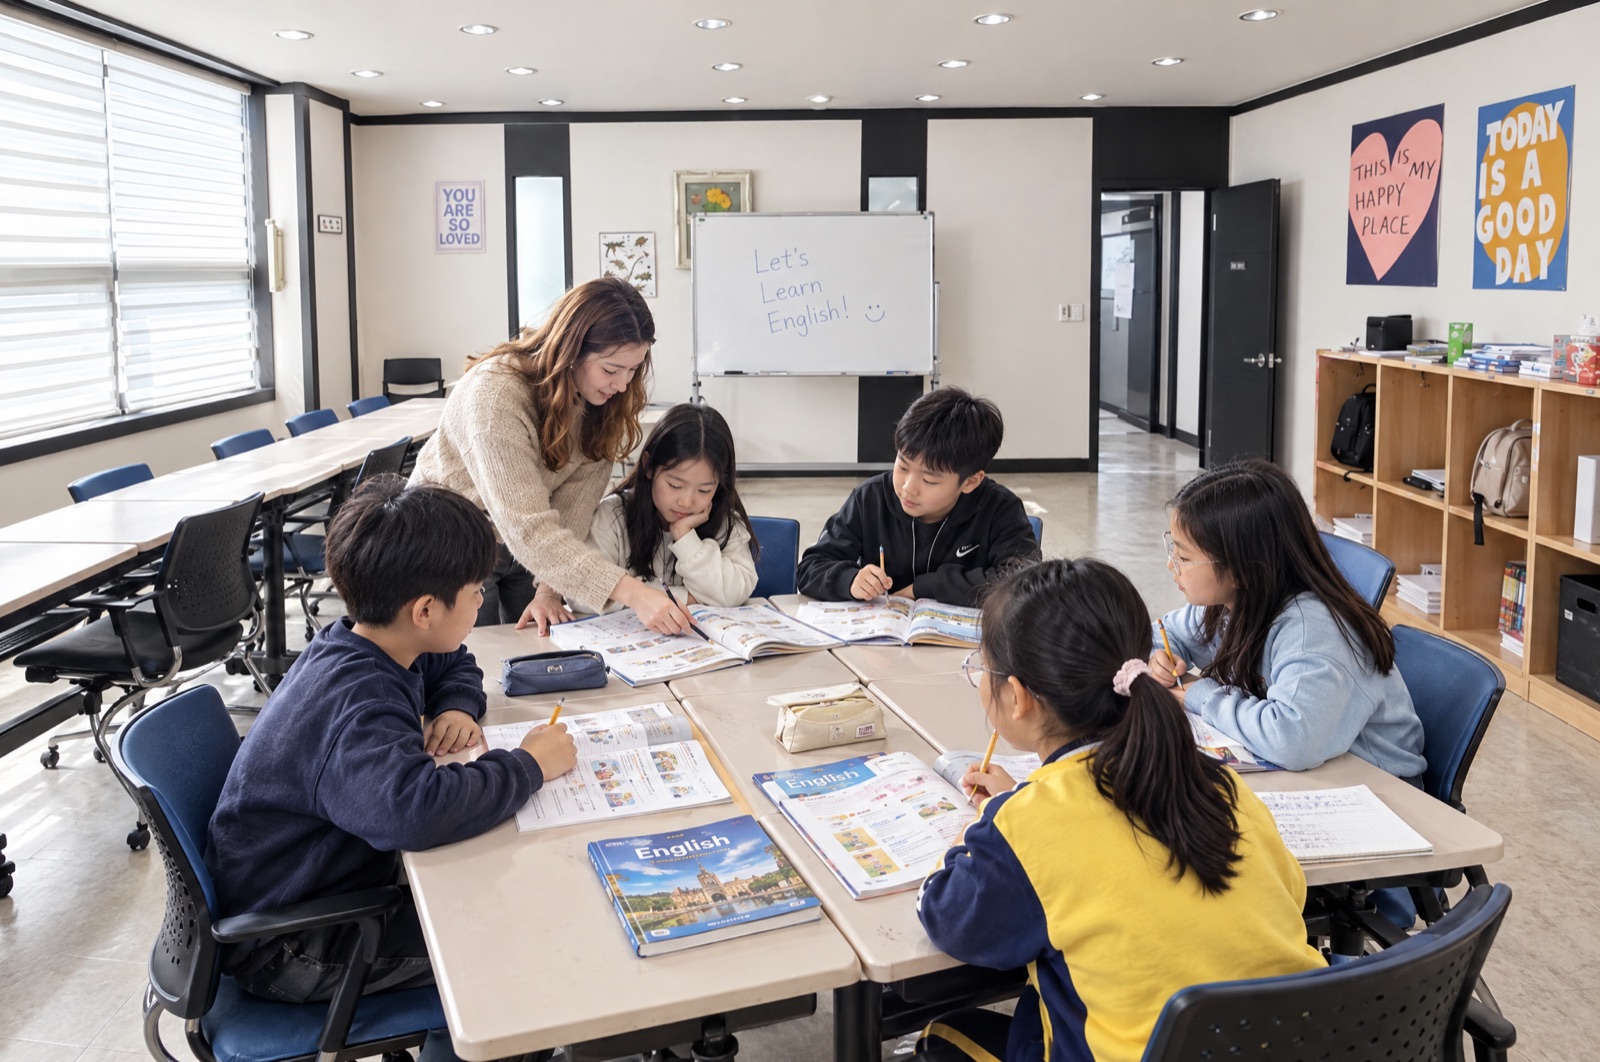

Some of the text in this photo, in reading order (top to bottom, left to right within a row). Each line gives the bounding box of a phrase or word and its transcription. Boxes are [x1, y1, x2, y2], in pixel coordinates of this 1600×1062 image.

[1486, 99, 1565, 156] TODAY
[1353, 148, 1437, 181] THIS IS MY
[1478, 148, 1542, 200] IS A
[442, 188, 476, 203] YOU
[1355, 182, 1405, 211] HAPPY
[443, 203, 474, 217] ARE
[1476, 193, 1556, 244] GOOD
[448, 218, 471, 231] SO
[1362, 215, 1410, 237] PLACE
[439, 232, 480, 245] LOVED
[754, 247, 809, 274] Let's
[1495, 238, 1554, 286] DAY
[760, 280, 823, 304] Learn
[767, 295, 849, 337] English!
[785, 769, 860, 789] English
[634, 835, 731, 860] English
